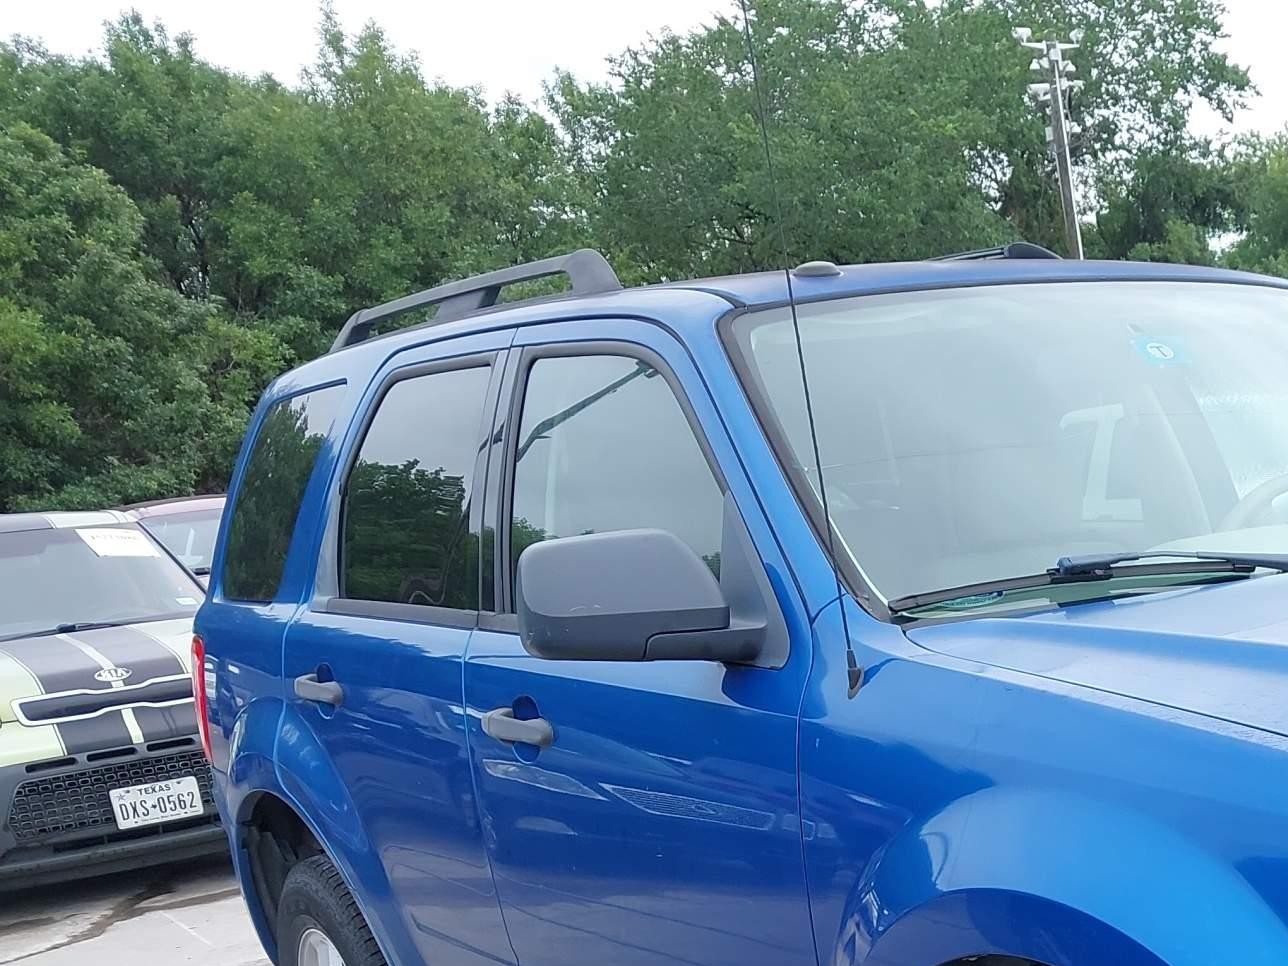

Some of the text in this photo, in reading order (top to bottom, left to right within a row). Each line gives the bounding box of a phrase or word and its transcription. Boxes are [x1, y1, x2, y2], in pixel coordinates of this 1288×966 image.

[136, 784, 172, 796] TEXAS
[119, 799, 150, 821] DXS
[156, 791, 197, 814] 0562
